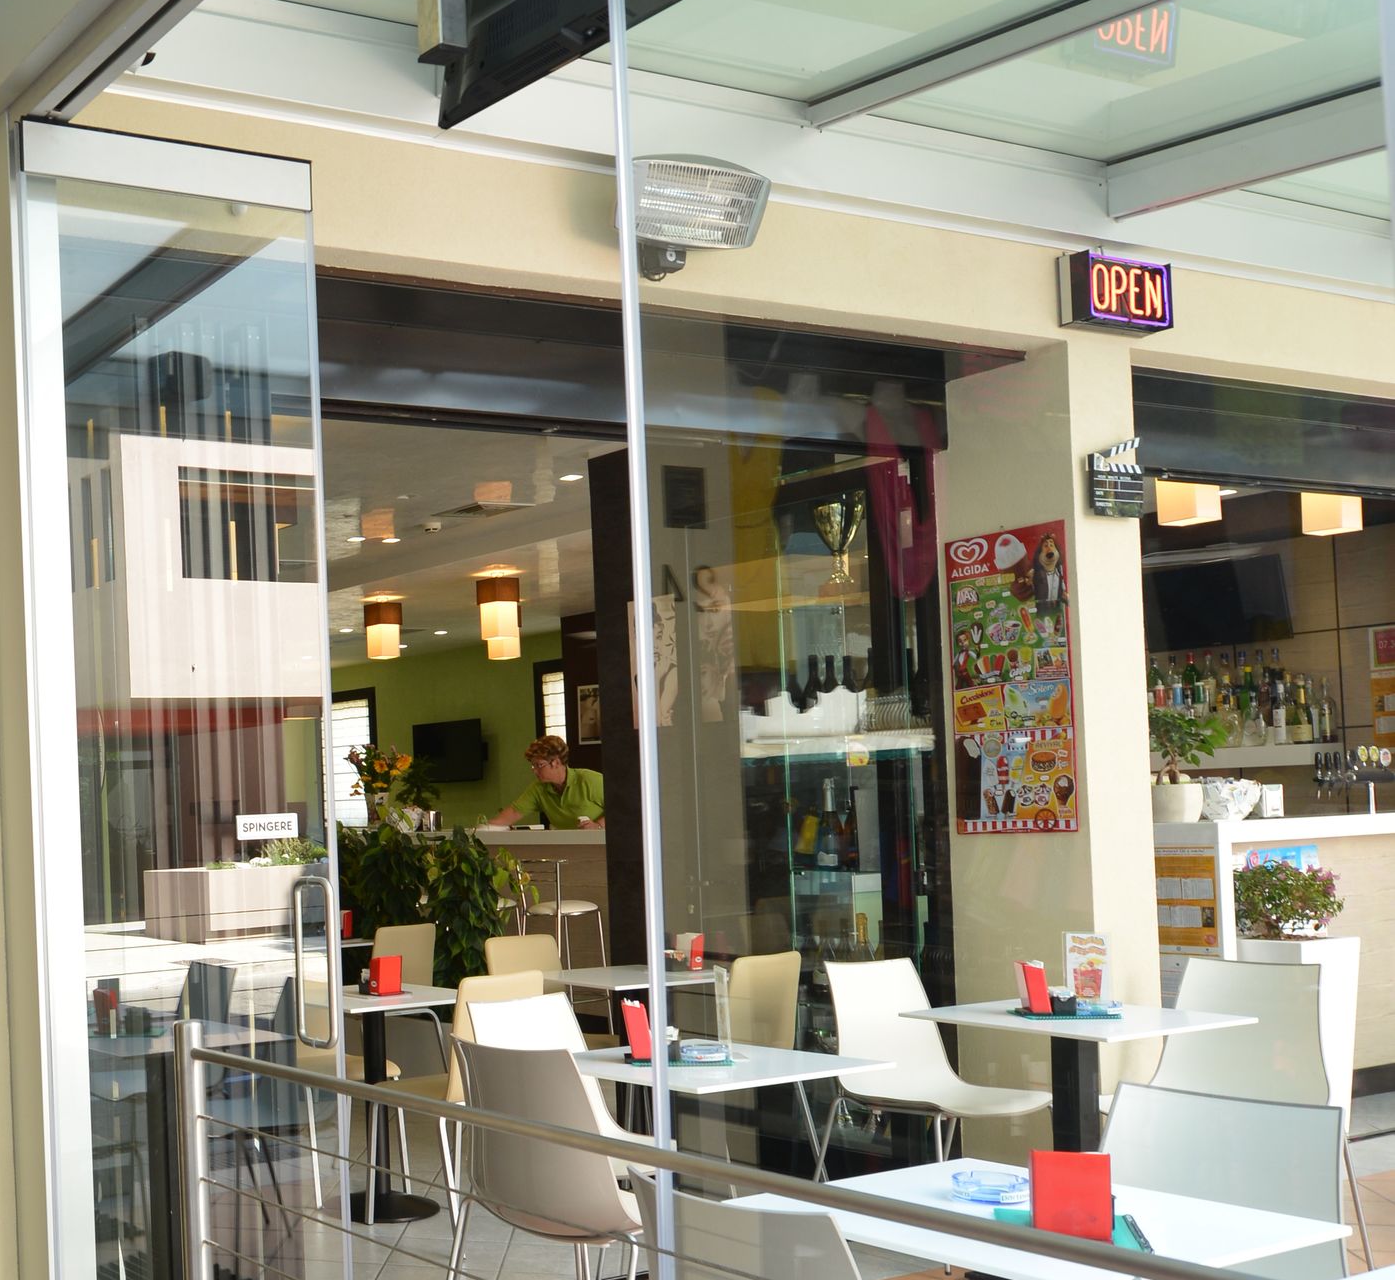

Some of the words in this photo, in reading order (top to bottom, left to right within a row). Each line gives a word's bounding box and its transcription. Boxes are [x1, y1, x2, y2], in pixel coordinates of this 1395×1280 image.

[1092, 262, 1163, 319] OPEN
[951, 563, 990, 579] ALGIDA
[242, 820, 293, 833] SPINGERE
